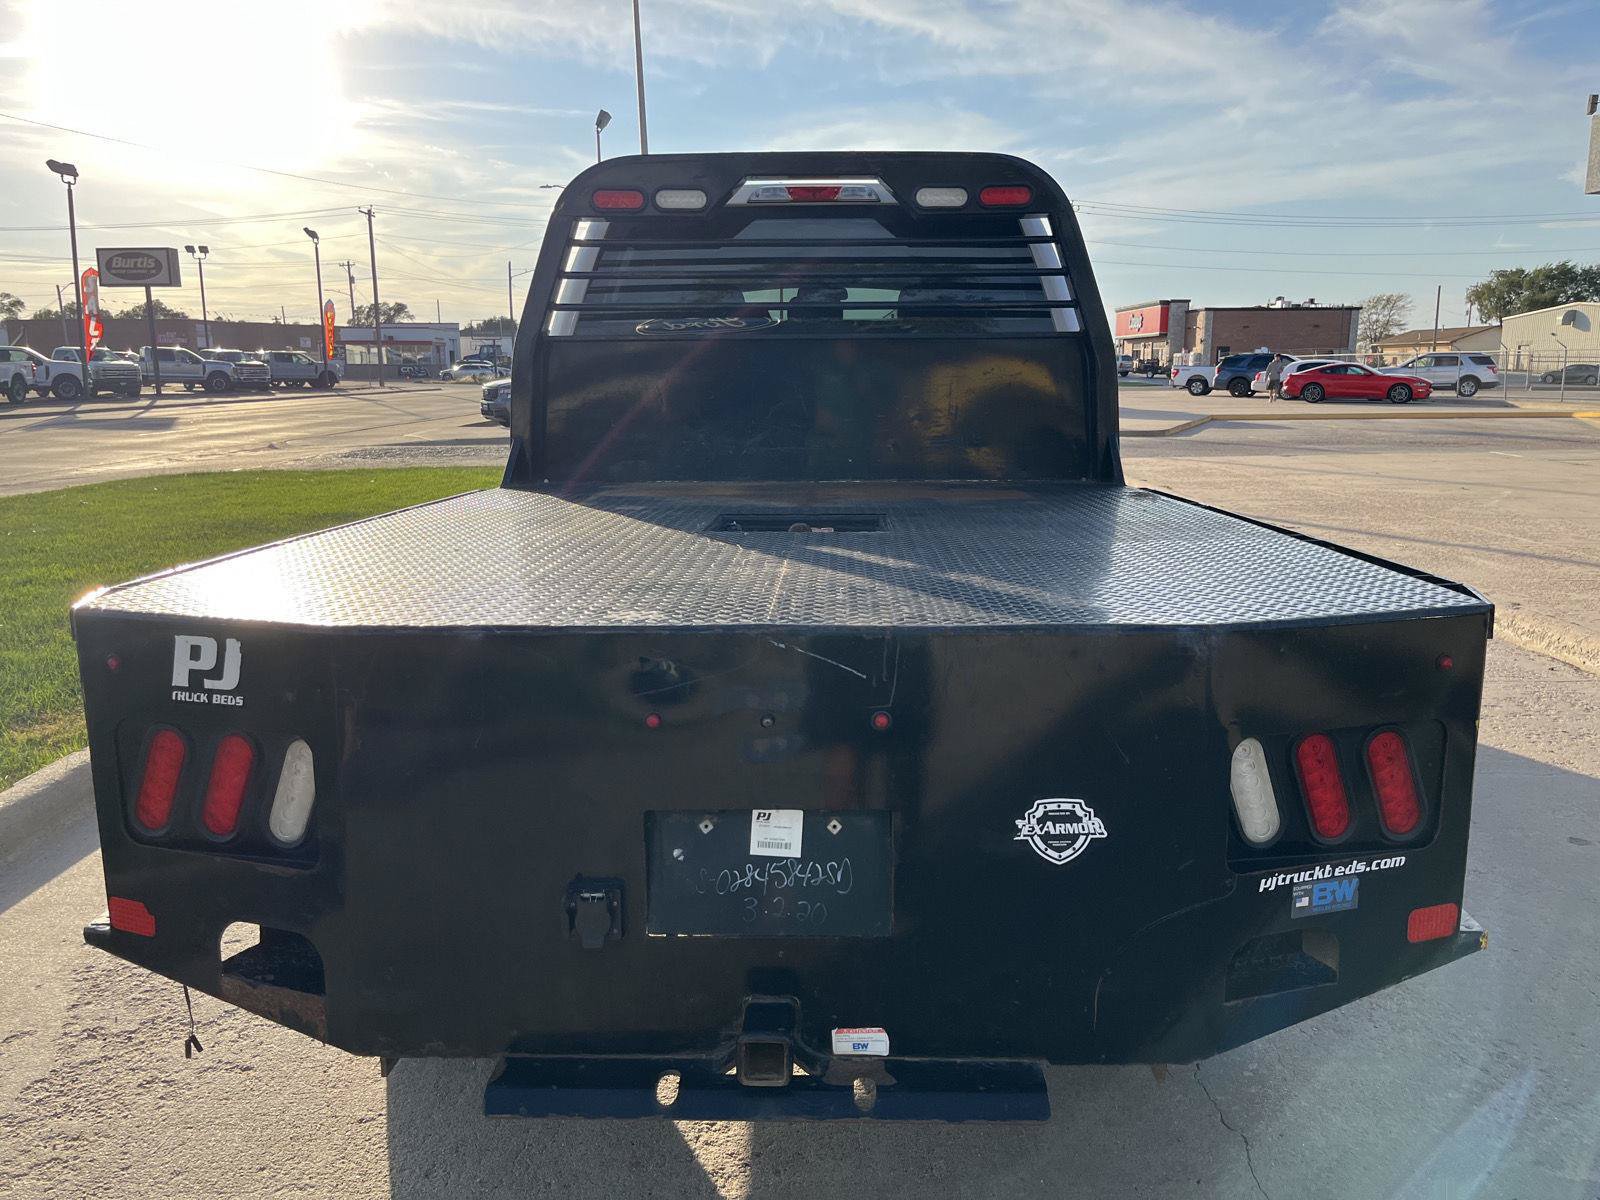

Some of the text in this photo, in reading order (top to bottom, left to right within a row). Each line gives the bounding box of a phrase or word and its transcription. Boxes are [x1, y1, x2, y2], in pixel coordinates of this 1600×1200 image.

[111, 256, 155, 269] Burtis
[172, 635, 242, 690] PJ
[172, 691, 244, 706] TRUCK BEDS
[756, 811, 772, 821] PJ
[1258, 856, 1406, 892] pjtruckbeds.com
